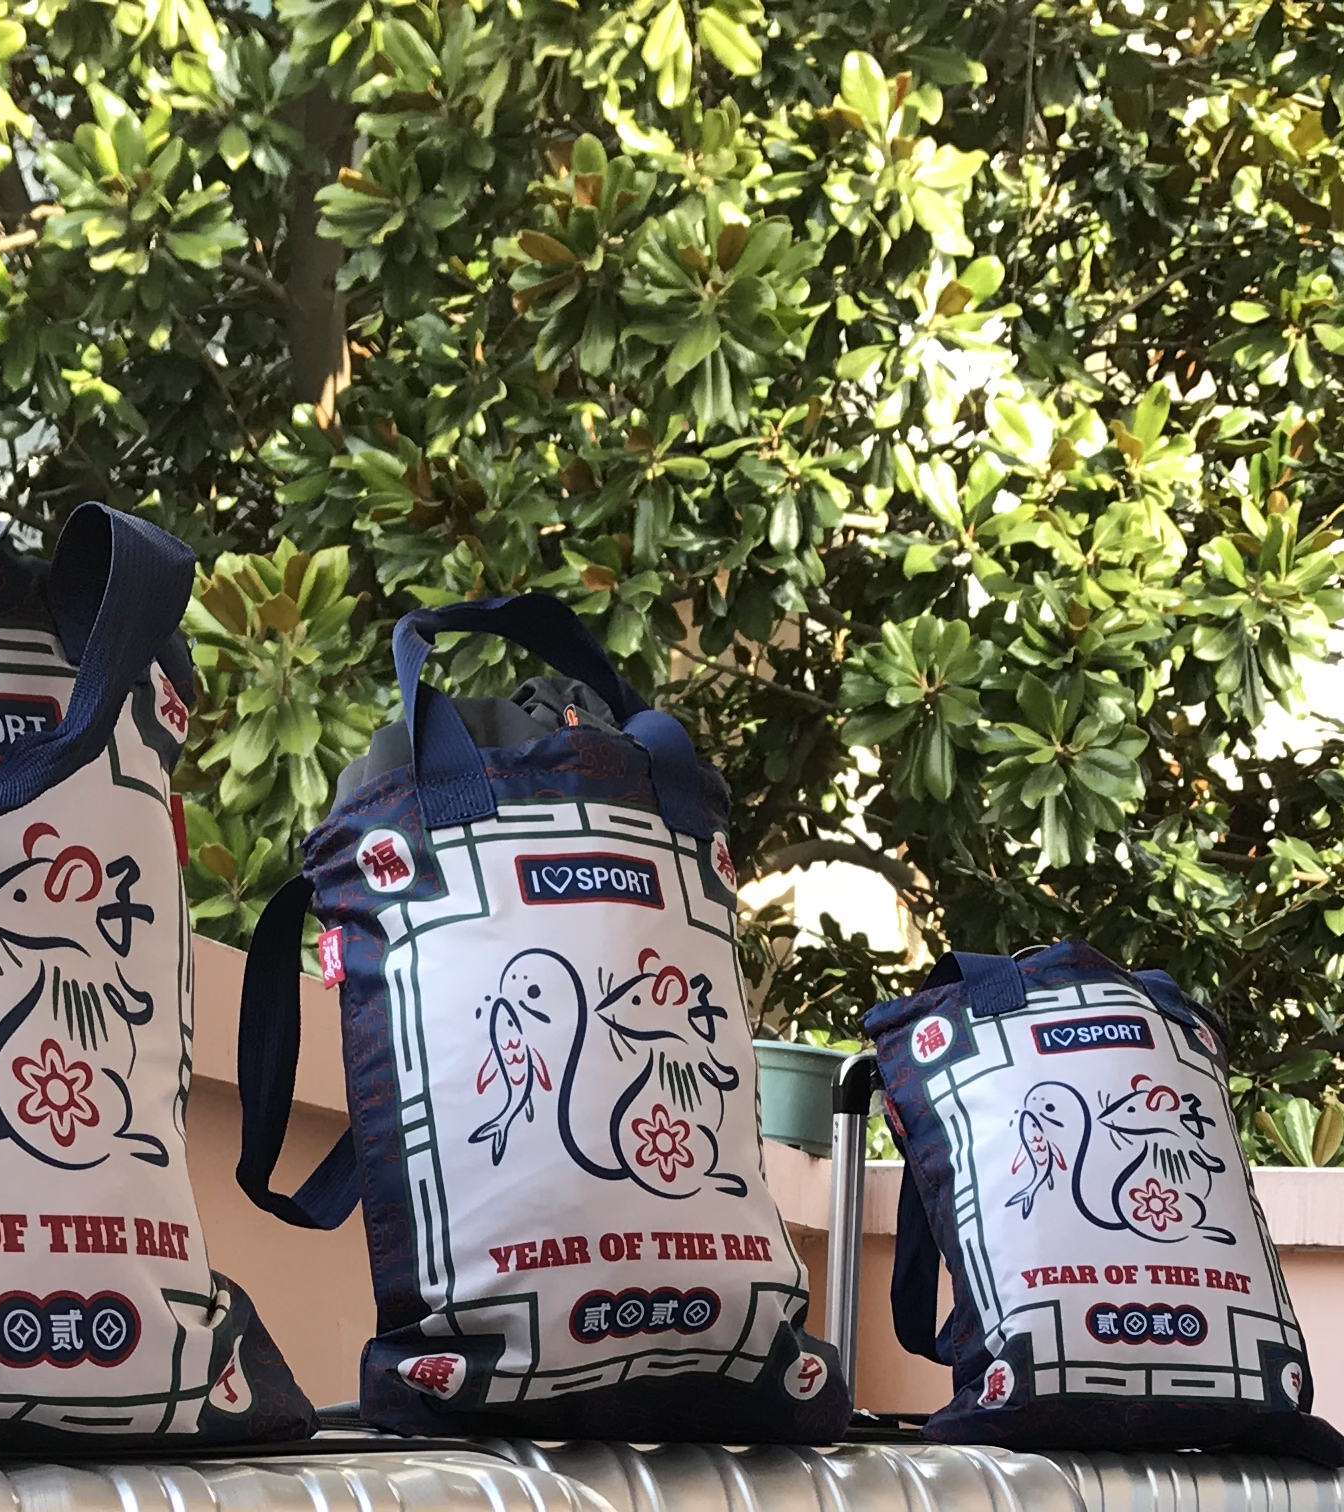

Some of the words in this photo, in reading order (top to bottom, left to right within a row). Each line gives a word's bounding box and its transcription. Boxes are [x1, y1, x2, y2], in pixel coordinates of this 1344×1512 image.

[362, 837, 411, 887] 福
[576, 868, 651, 896] SPORT
[916, 1020, 952, 1058] 福
[1076, 1023, 1142, 1044] SPORT
[40, 1214, 128, 1254] THE
[134, 1217, 190, 1261] RAT
[489, 1235, 591, 1273] YEAR
[599, 1232, 643, 1262] OF
[651, 1231, 718, 1261] THE
[721, 1233, 773, 1262] RAT
[1021, 1265, 1098, 1289] YEAR
[1104, 1265, 1139, 1284] OF
[1145, 1265, 1200, 1287] THE
[1205, 1268, 1251, 1294] RAT
